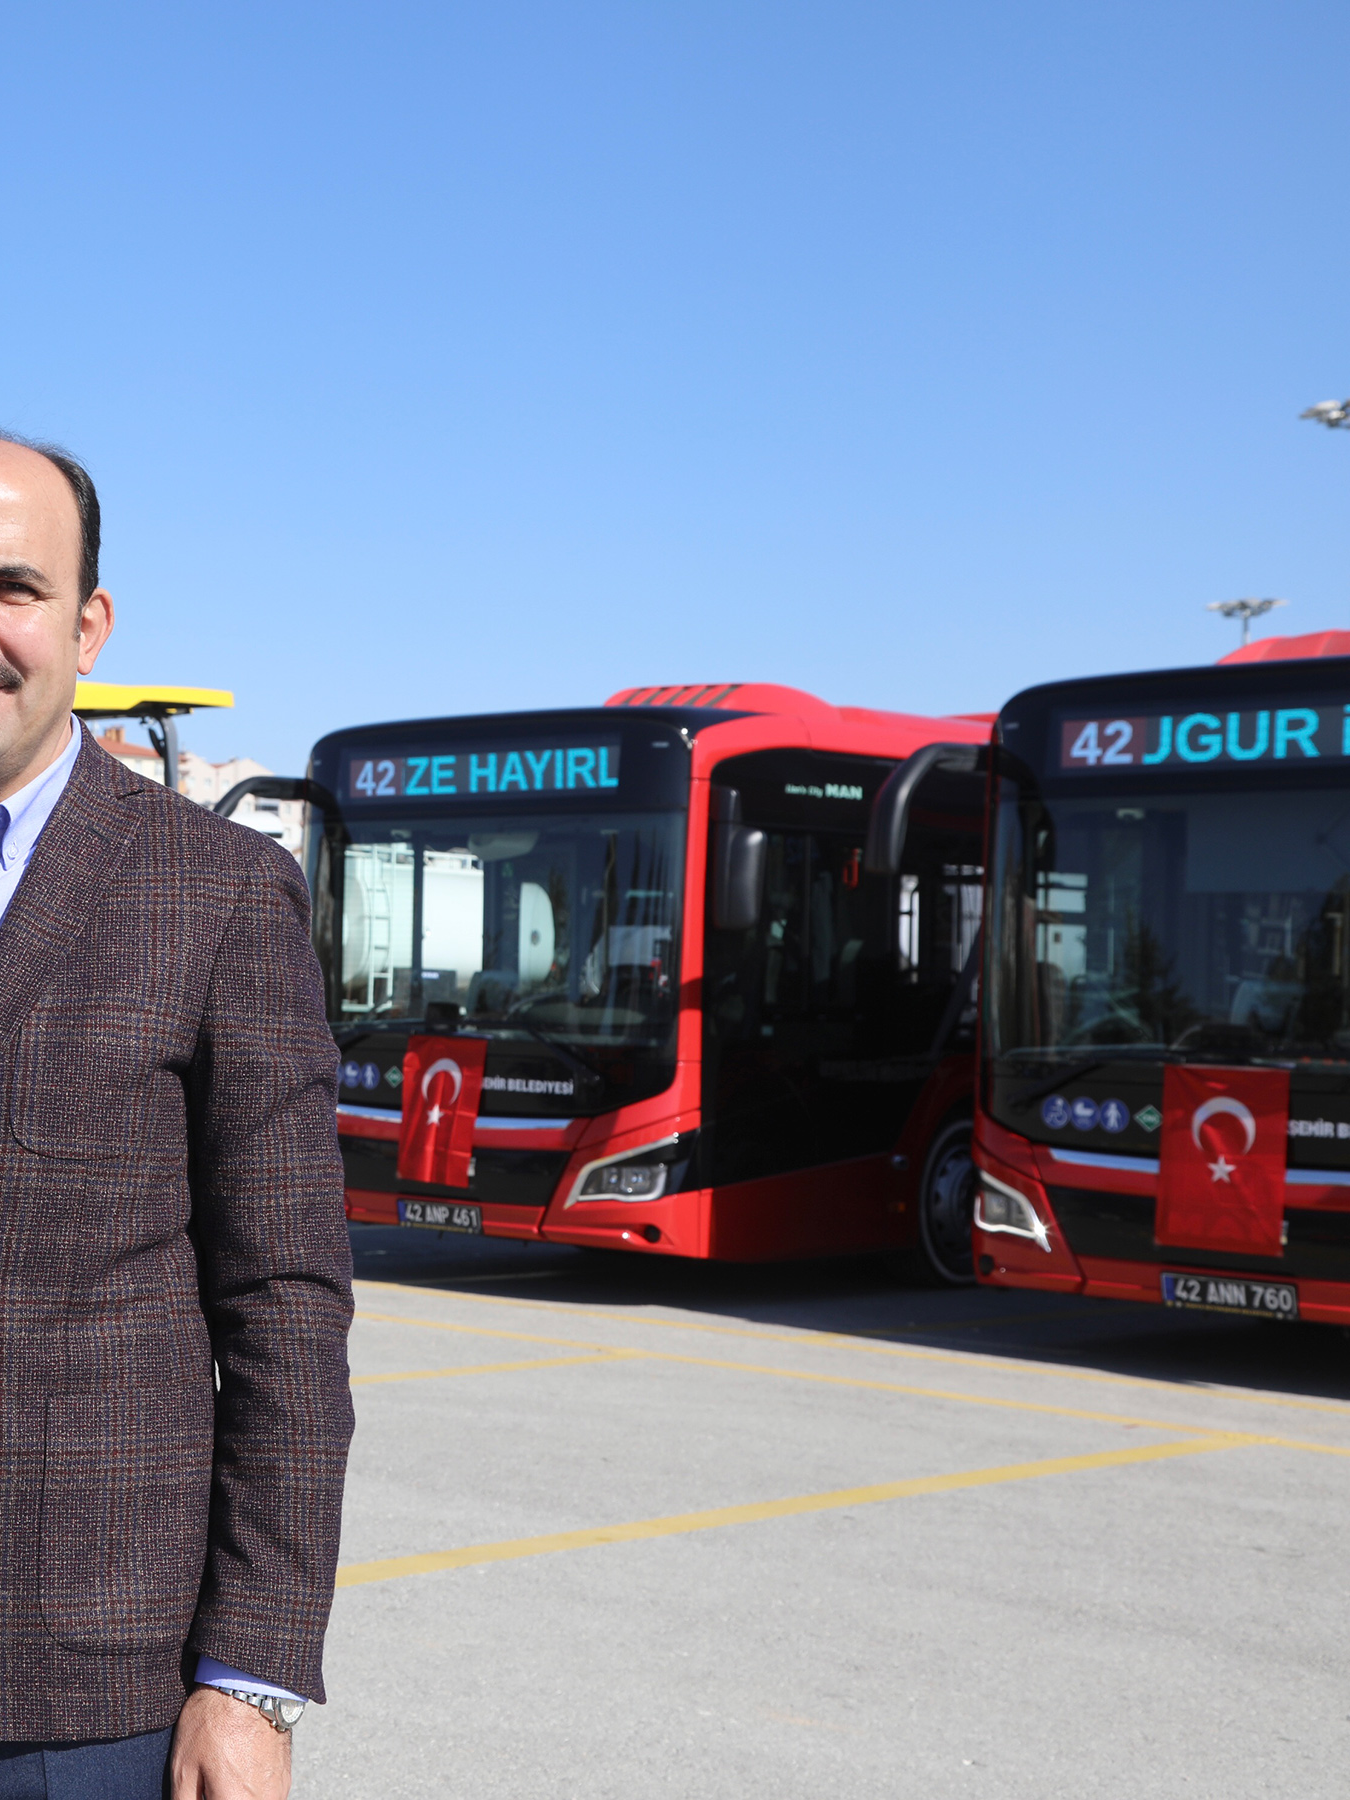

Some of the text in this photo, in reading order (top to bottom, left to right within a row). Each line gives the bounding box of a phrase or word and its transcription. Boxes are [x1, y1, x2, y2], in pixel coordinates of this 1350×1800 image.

[1070, 719, 1134, 766] 42
[355, 746, 619, 796] 42 ZE HAYIRL
[825, 783, 863, 800] MAN
[405, 1203, 424, 1222] 42
[425, 1204, 450, 1224] ANP
[452, 1206, 478, 1228] 461
[1174, 1278, 1202, 1302] 42
[1206, 1281, 1247, 1307] ANN
[1251, 1285, 1293, 1312] 760
